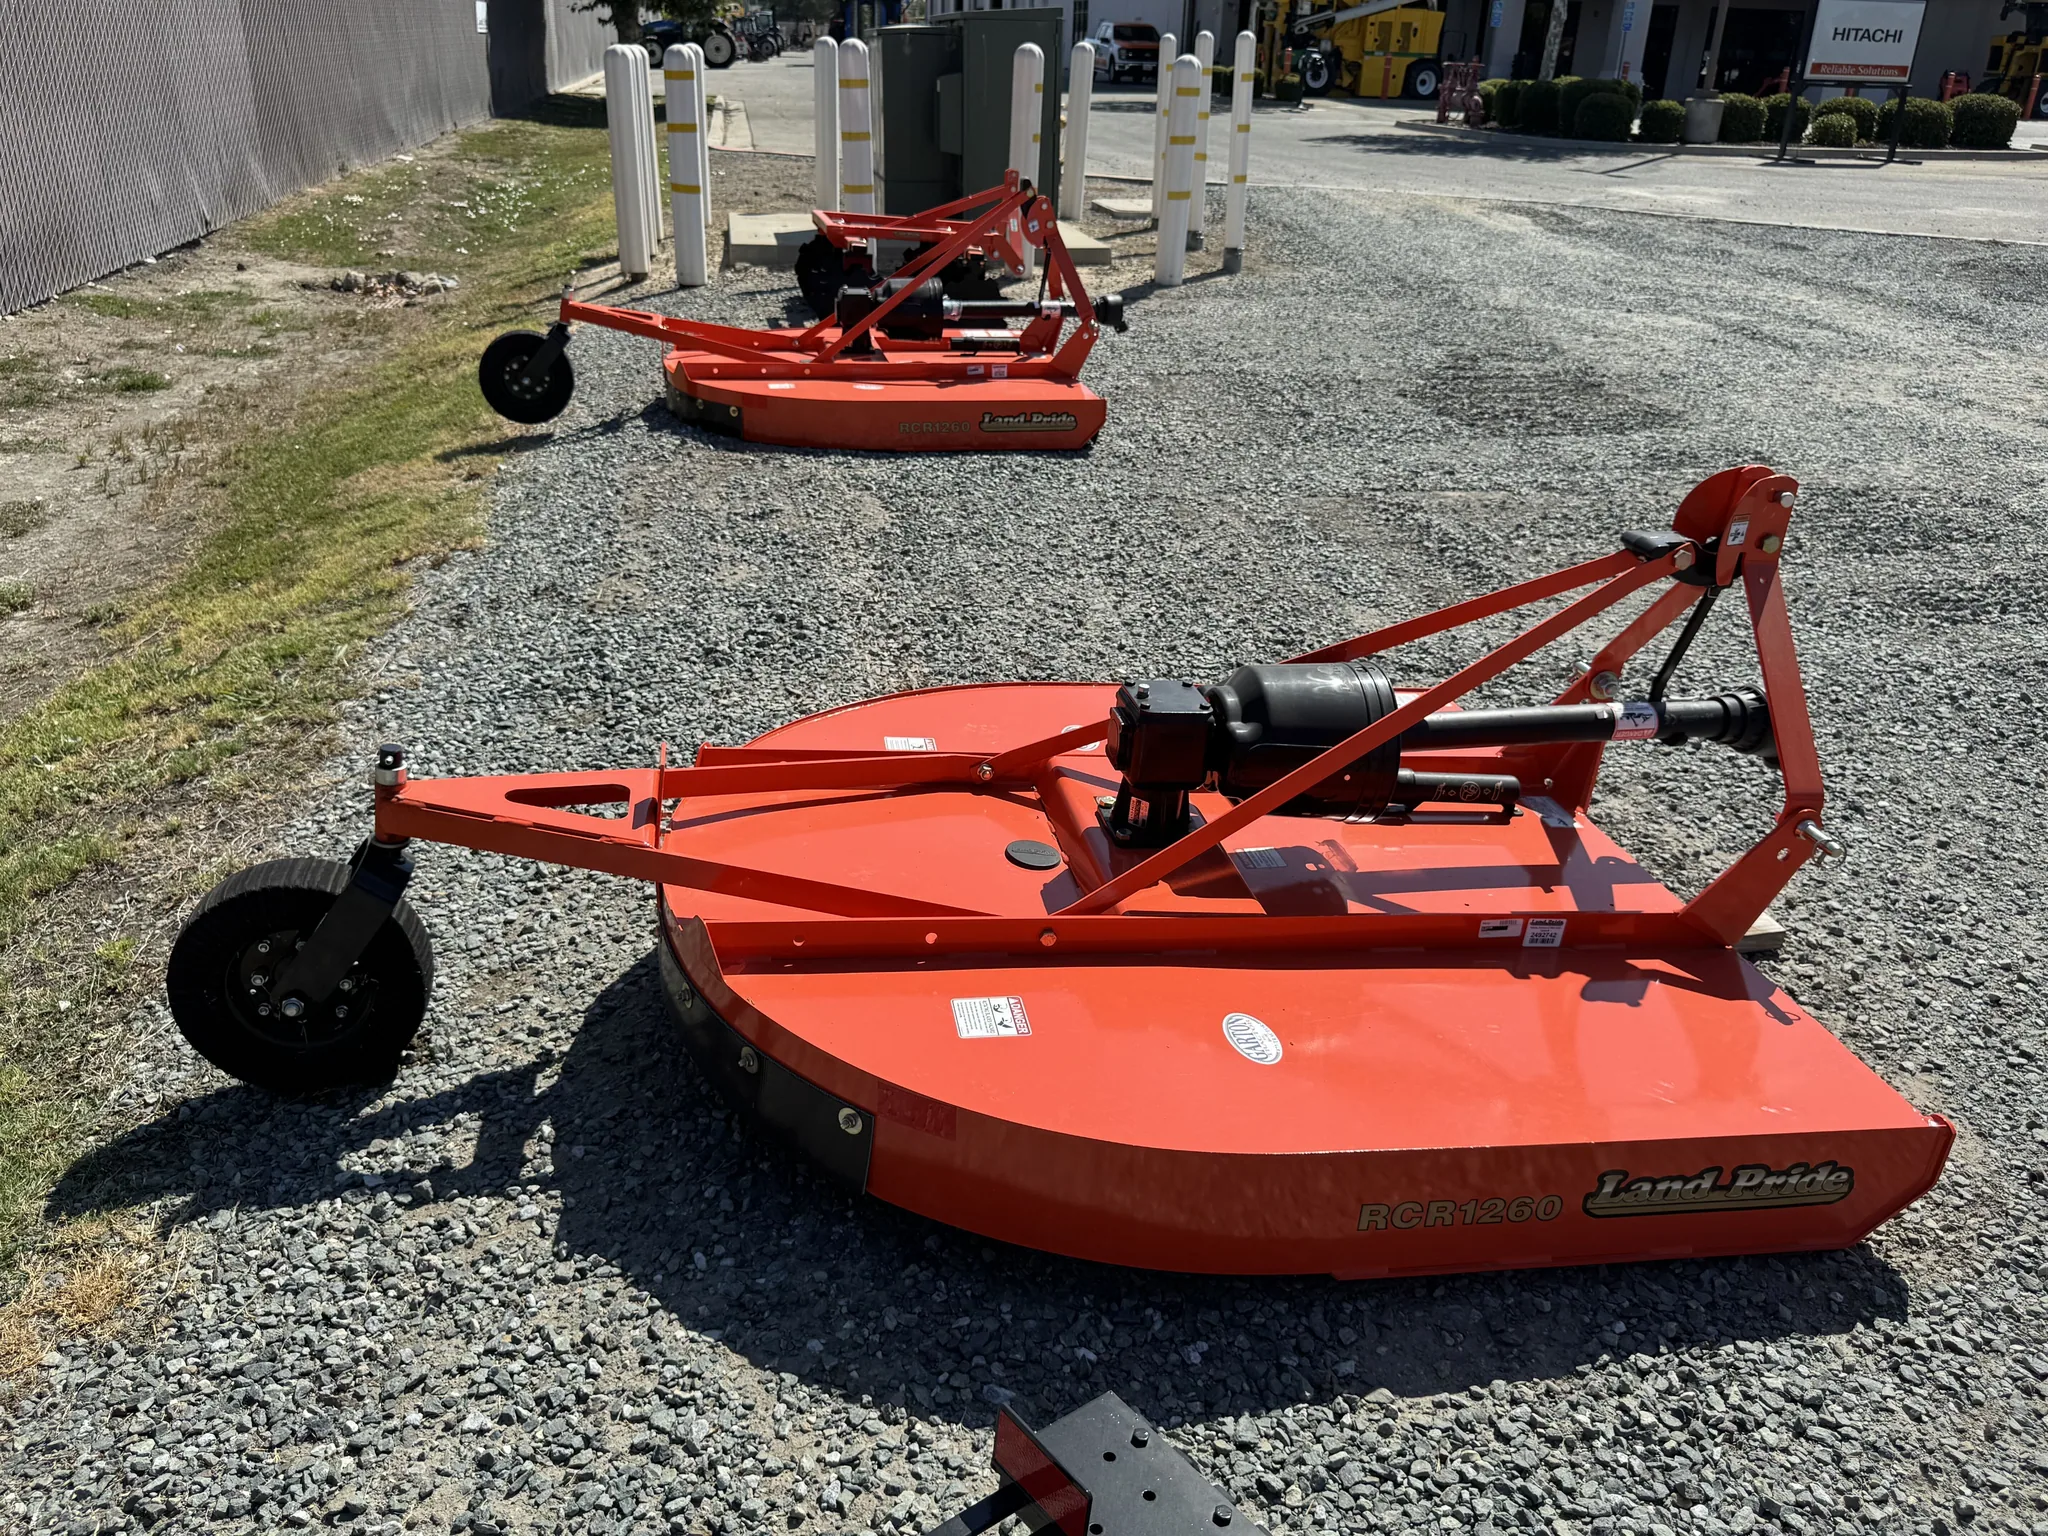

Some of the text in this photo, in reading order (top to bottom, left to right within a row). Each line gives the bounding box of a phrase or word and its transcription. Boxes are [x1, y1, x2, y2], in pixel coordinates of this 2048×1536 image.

[1832, 27, 1903, 43] HITACHI
[1820, 64, 1898, 76] Reliable Solutions
[899, 422, 971, 433] RCR1260
[982, 413, 1076, 425] Land Pride
[1011, 1002, 1028, 1034] DANGER
[1228, 1018, 1269, 1060] GARTON
[1592, 1164, 1850, 1203] Land Pride
[1357, 1196, 1563, 1231] RCR1260
